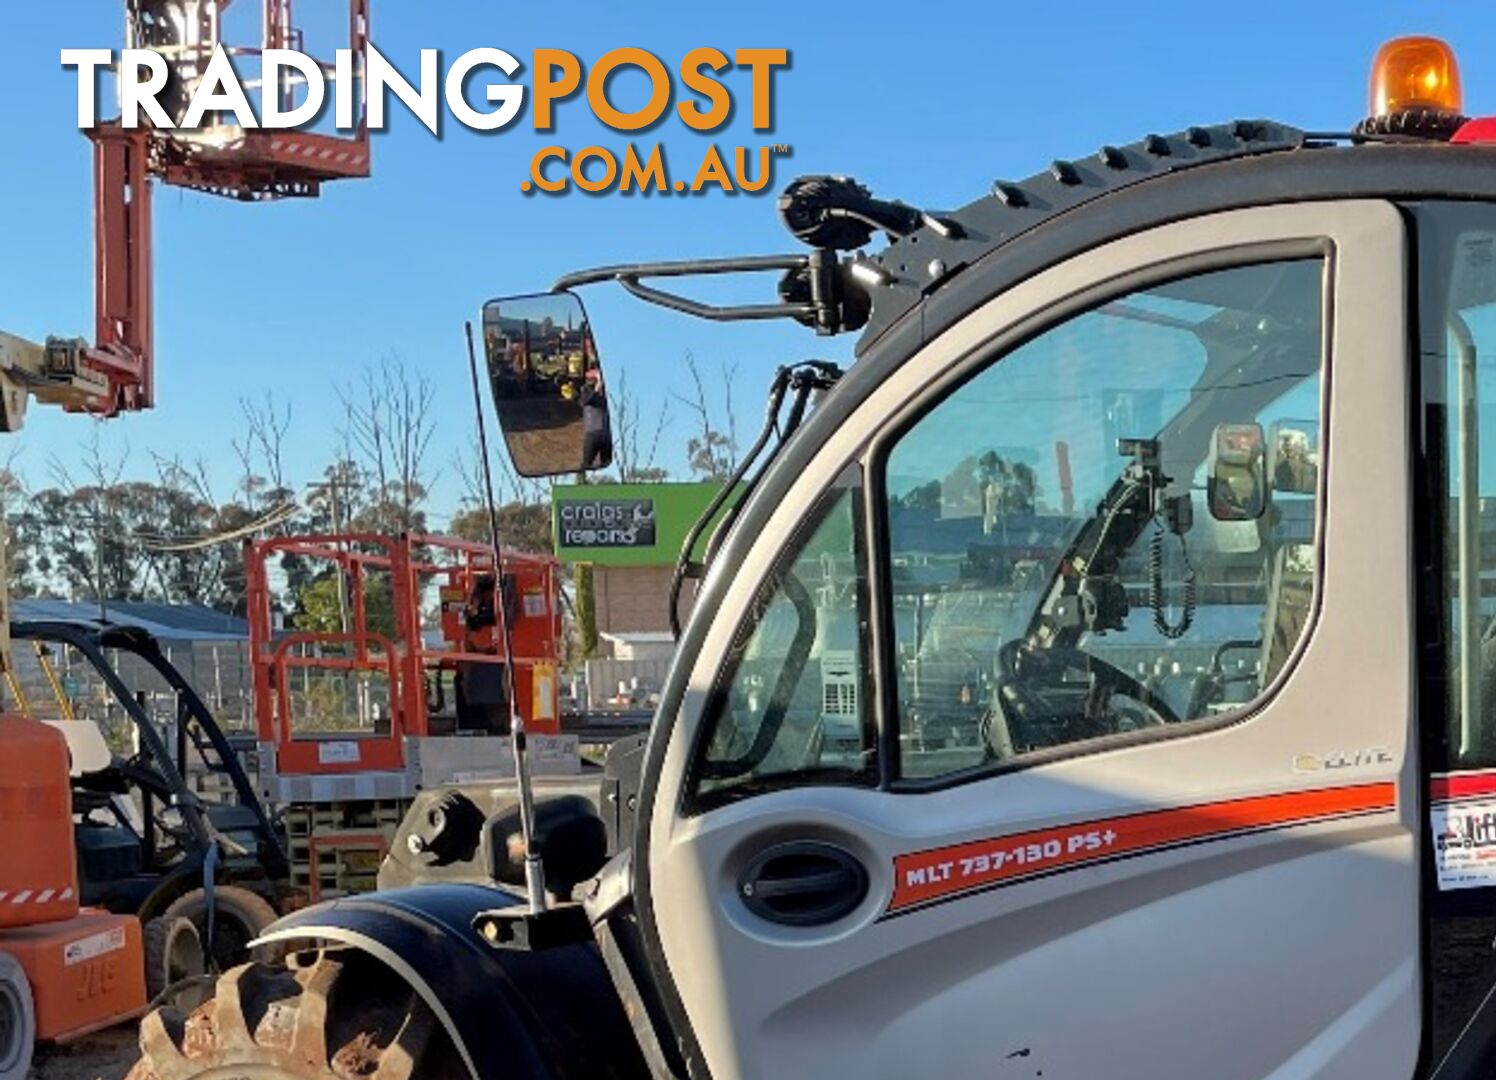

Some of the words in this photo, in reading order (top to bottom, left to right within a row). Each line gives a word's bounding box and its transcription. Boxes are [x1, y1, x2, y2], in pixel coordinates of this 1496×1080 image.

[906, 862, 953, 886] MLT
[960, 840, 1062, 876] 737-130
[1067, 828, 1117, 854] PS+
